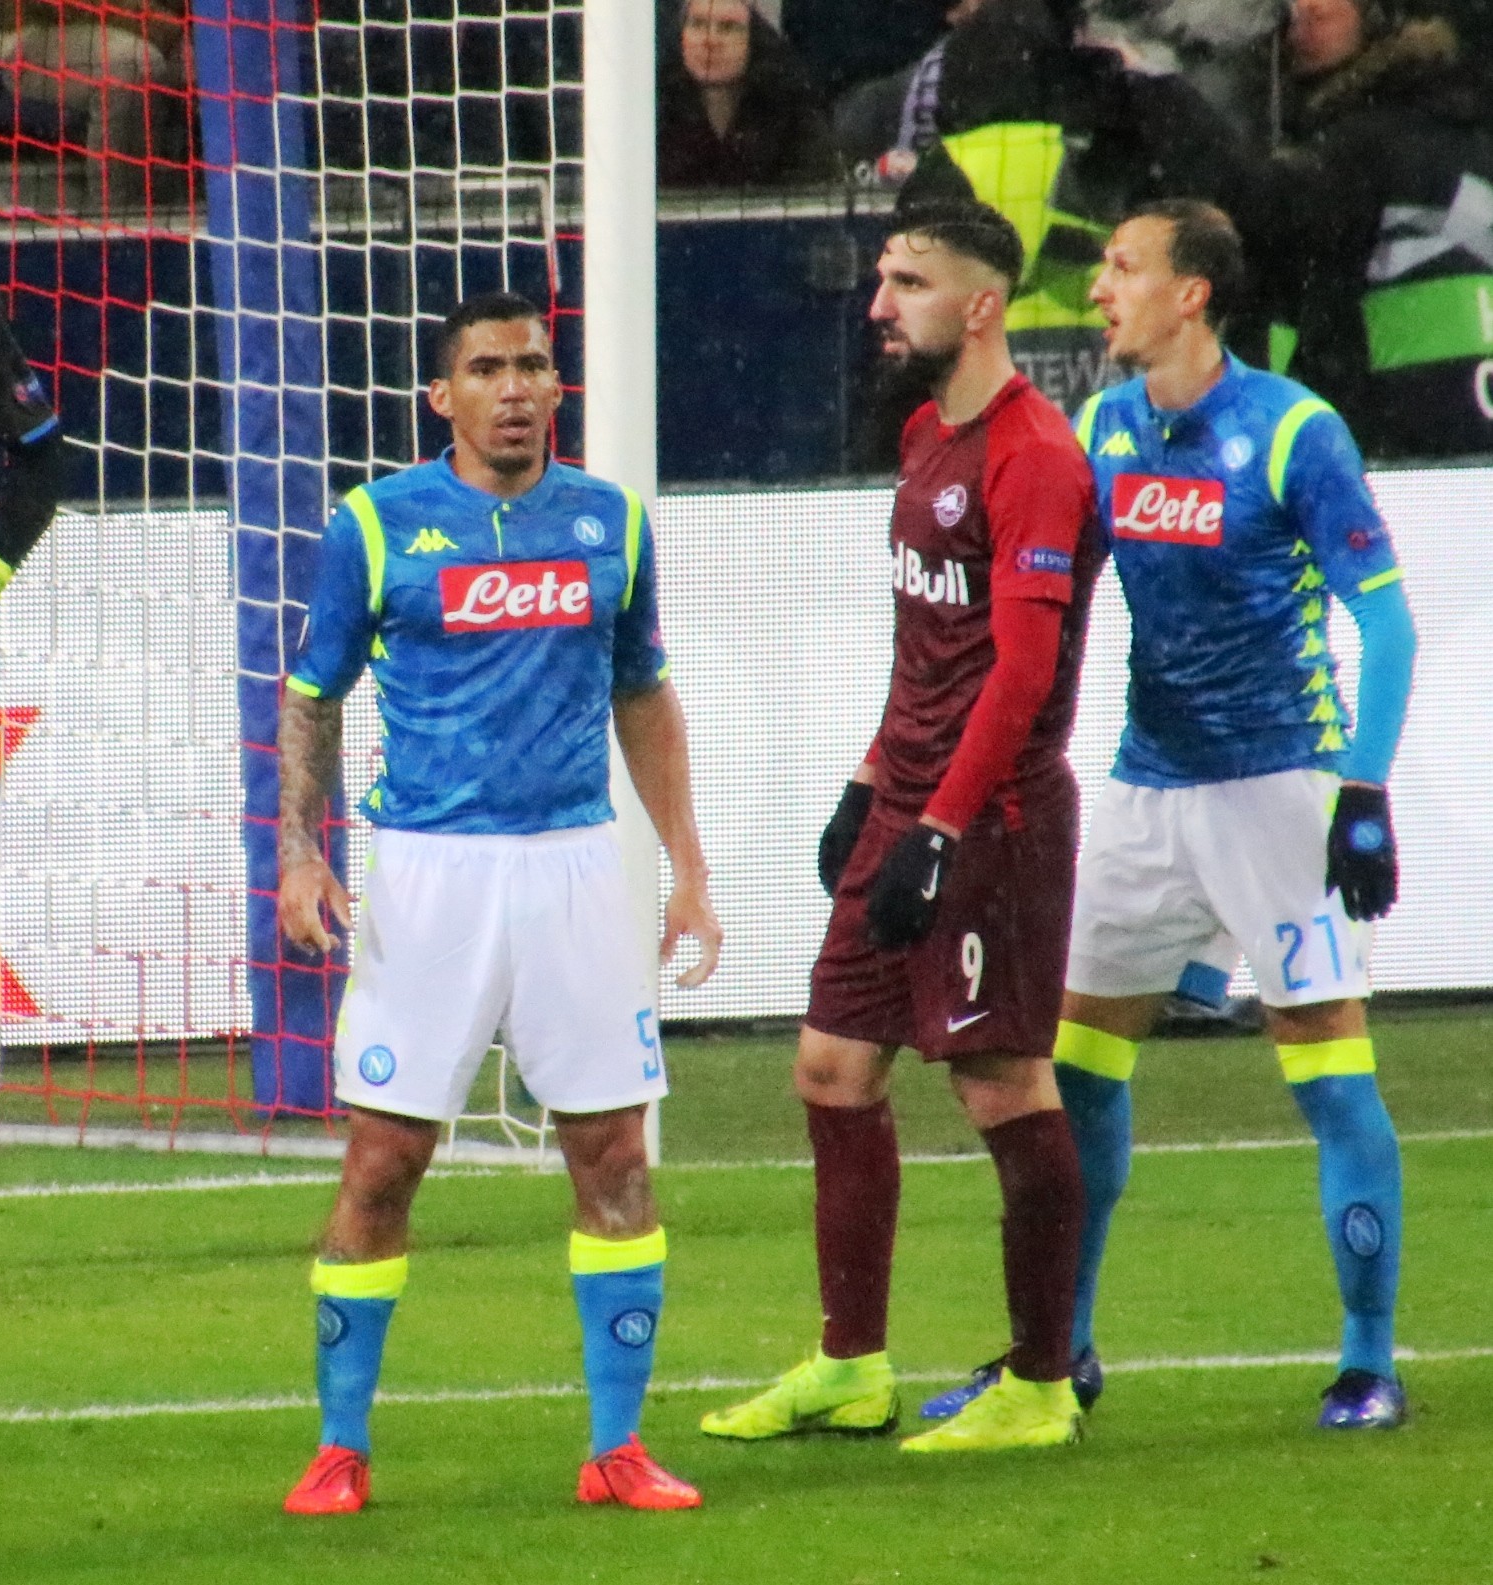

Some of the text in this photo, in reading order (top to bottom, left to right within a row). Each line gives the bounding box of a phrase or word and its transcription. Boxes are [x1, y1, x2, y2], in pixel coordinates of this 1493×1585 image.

[1114, 481, 1224, 534] Lete
[444, 570, 589, 624] Lete
[961, 931, 984, 1002] 9
[635, 1007, 661, 1081] 5
